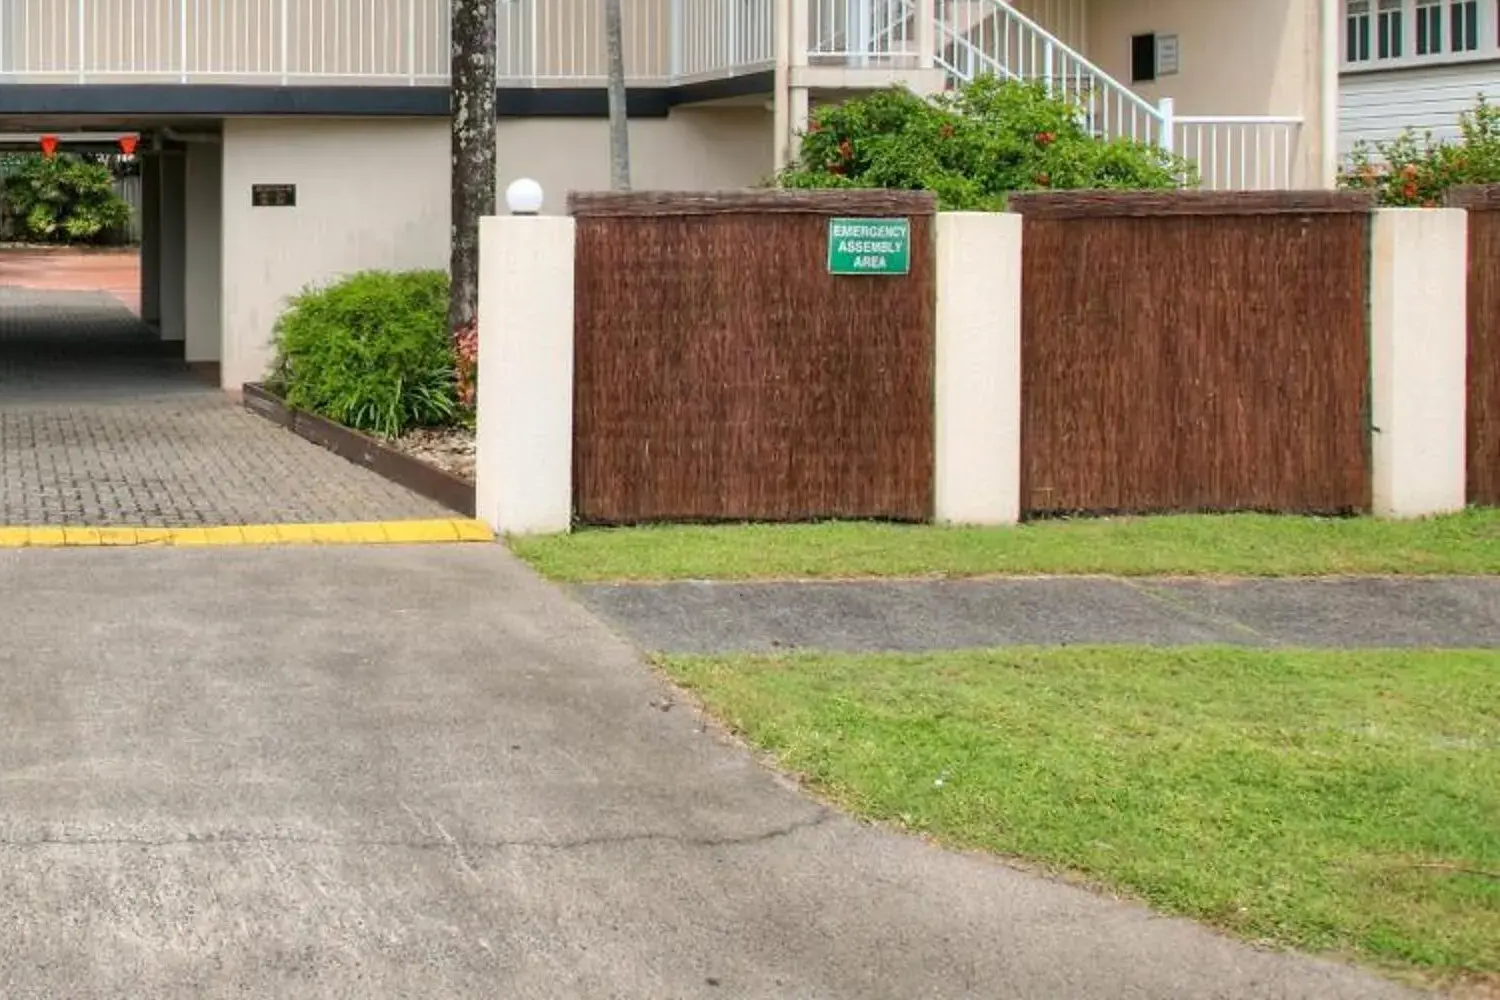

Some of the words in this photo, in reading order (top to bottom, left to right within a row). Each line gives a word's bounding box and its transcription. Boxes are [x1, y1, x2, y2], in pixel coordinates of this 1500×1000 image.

[833, 225, 906, 237] EMERGENCY
[837, 240, 903, 253] ASSEMBLY
[853, 255, 887, 269] AREA
